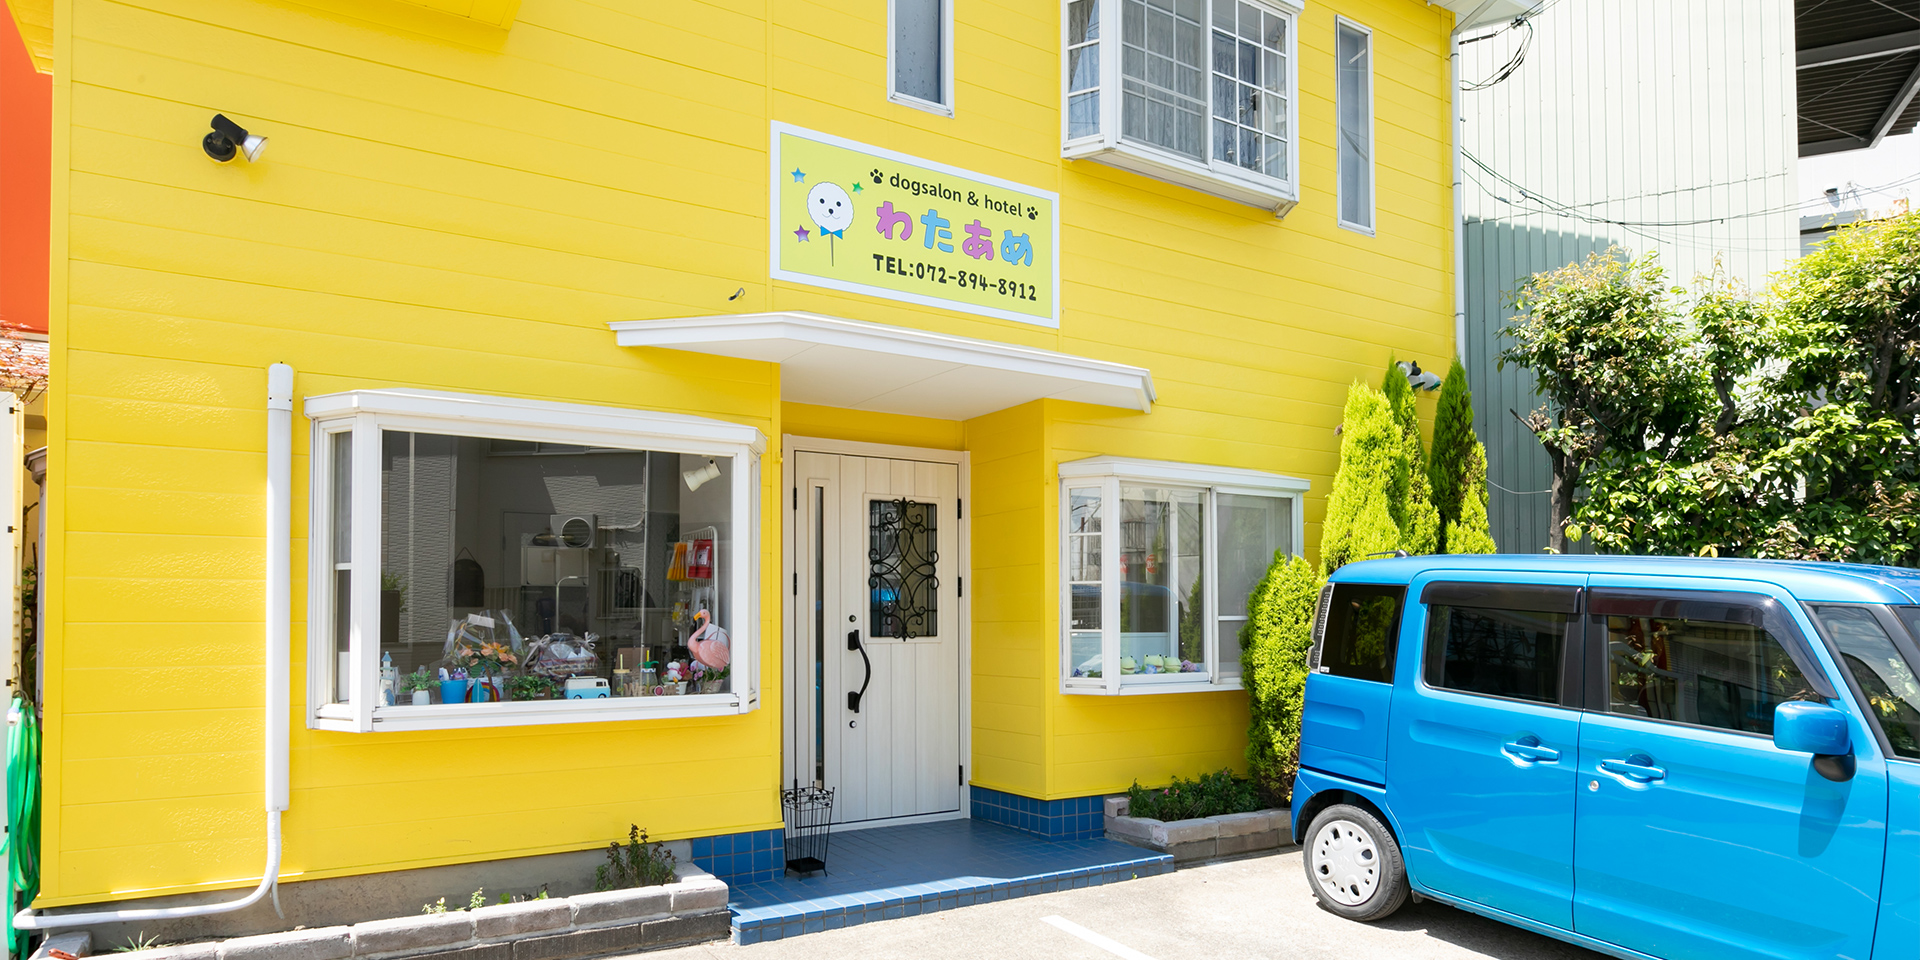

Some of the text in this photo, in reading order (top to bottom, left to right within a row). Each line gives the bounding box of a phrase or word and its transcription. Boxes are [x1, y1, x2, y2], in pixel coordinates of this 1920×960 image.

[889, 172, 1023, 217] dogsalon & hotel
[876, 201, 1033, 267] わたあめ
[872, 253, 1037, 302] TEL:072-894-8912
